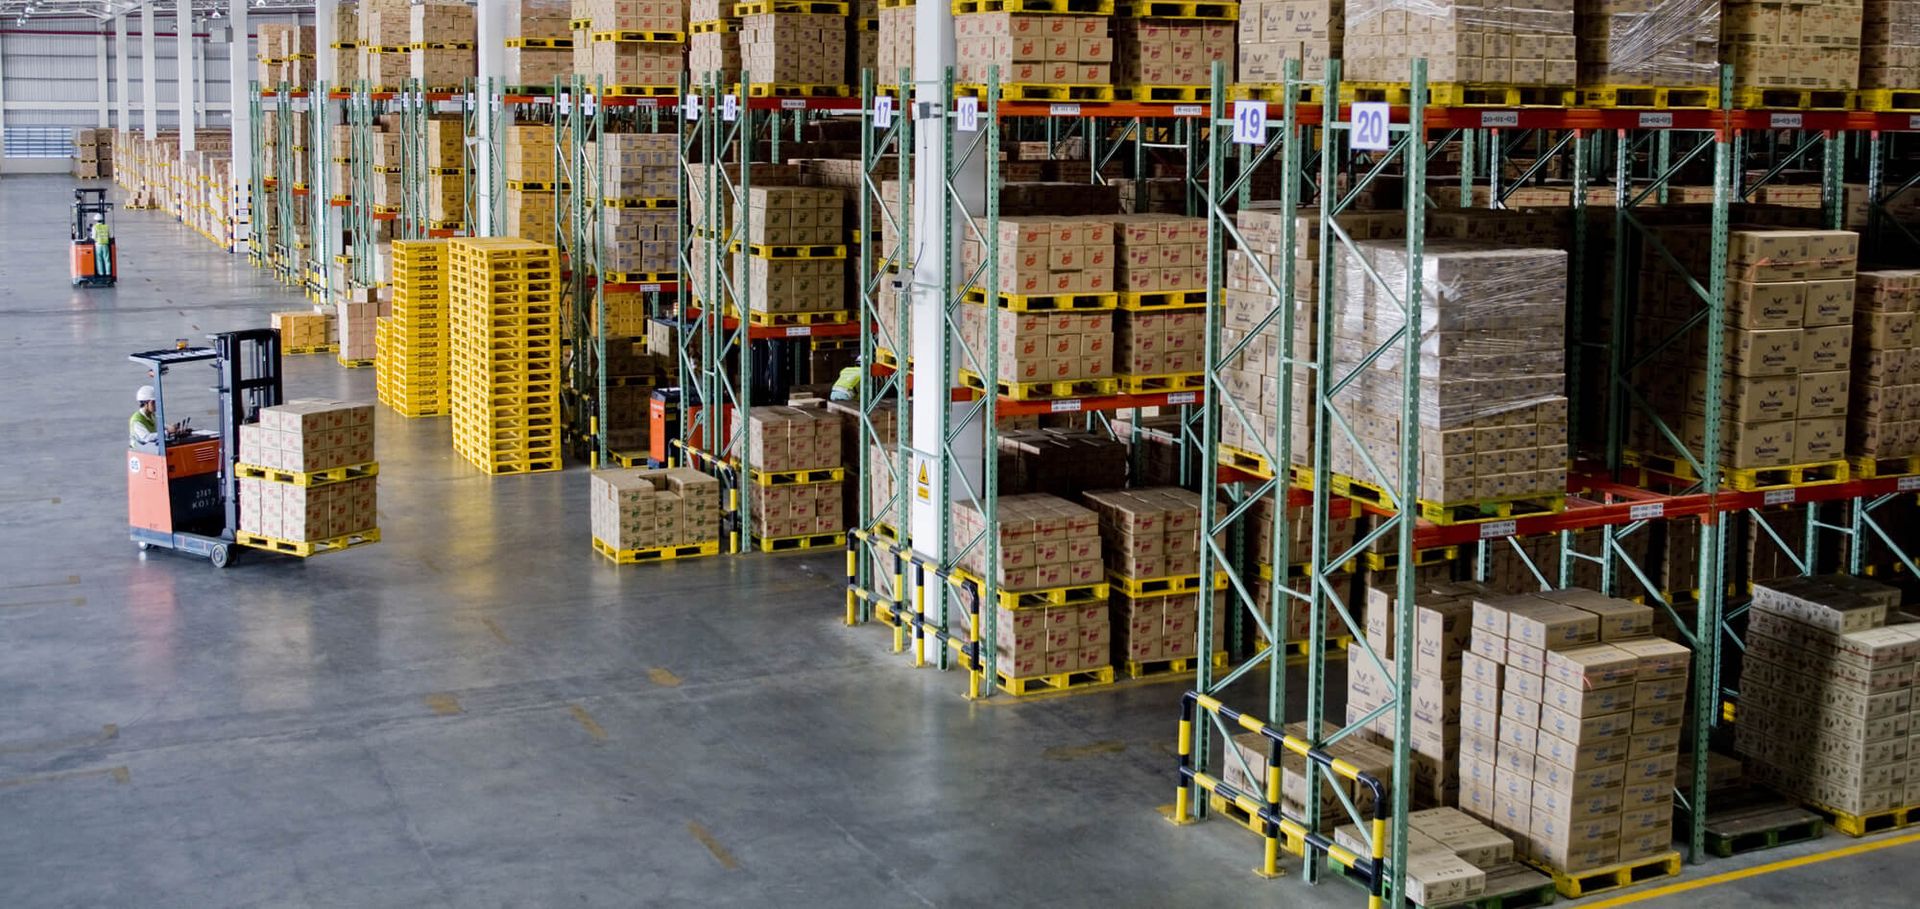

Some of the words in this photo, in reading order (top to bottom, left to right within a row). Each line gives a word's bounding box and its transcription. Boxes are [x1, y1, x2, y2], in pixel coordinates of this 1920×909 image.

[725, 98, 734, 118] 16
[877, 101, 889, 124] 17
[960, 103, 975, 127] 18
[1239, 102, 1261, 139] 19
[1357, 110, 1383, 144] 20
